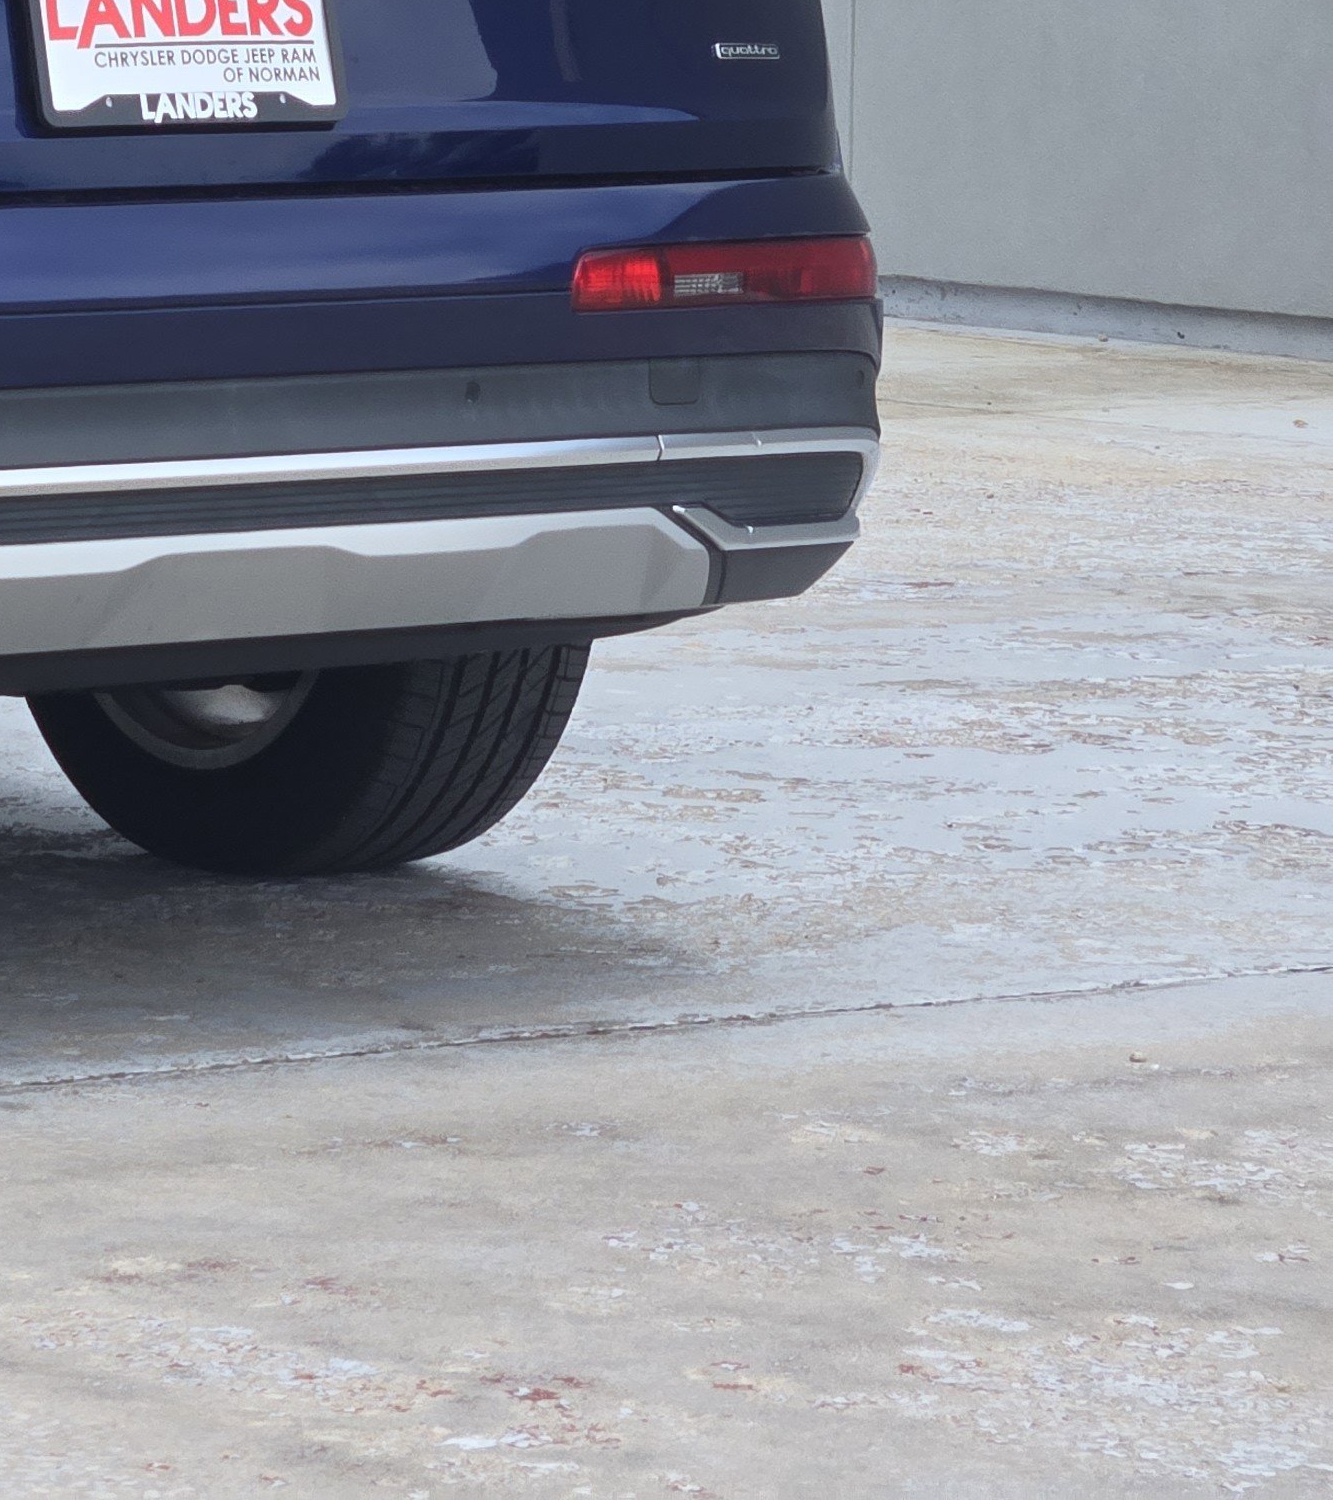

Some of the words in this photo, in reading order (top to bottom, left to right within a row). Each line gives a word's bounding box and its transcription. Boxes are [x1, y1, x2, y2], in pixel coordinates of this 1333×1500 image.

[94, 50, 176, 68] CHRYSLER
[181, 48, 240, 64] DODGE
[243, 48, 275, 64] JEEP
[281, 48, 317, 63] RAM
[720, 44, 778, 57] quattro
[223, 67, 244, 82] OF
[248, 66, 321, 82] NORMAN
[139, 91, 259, 124] LANDERS
